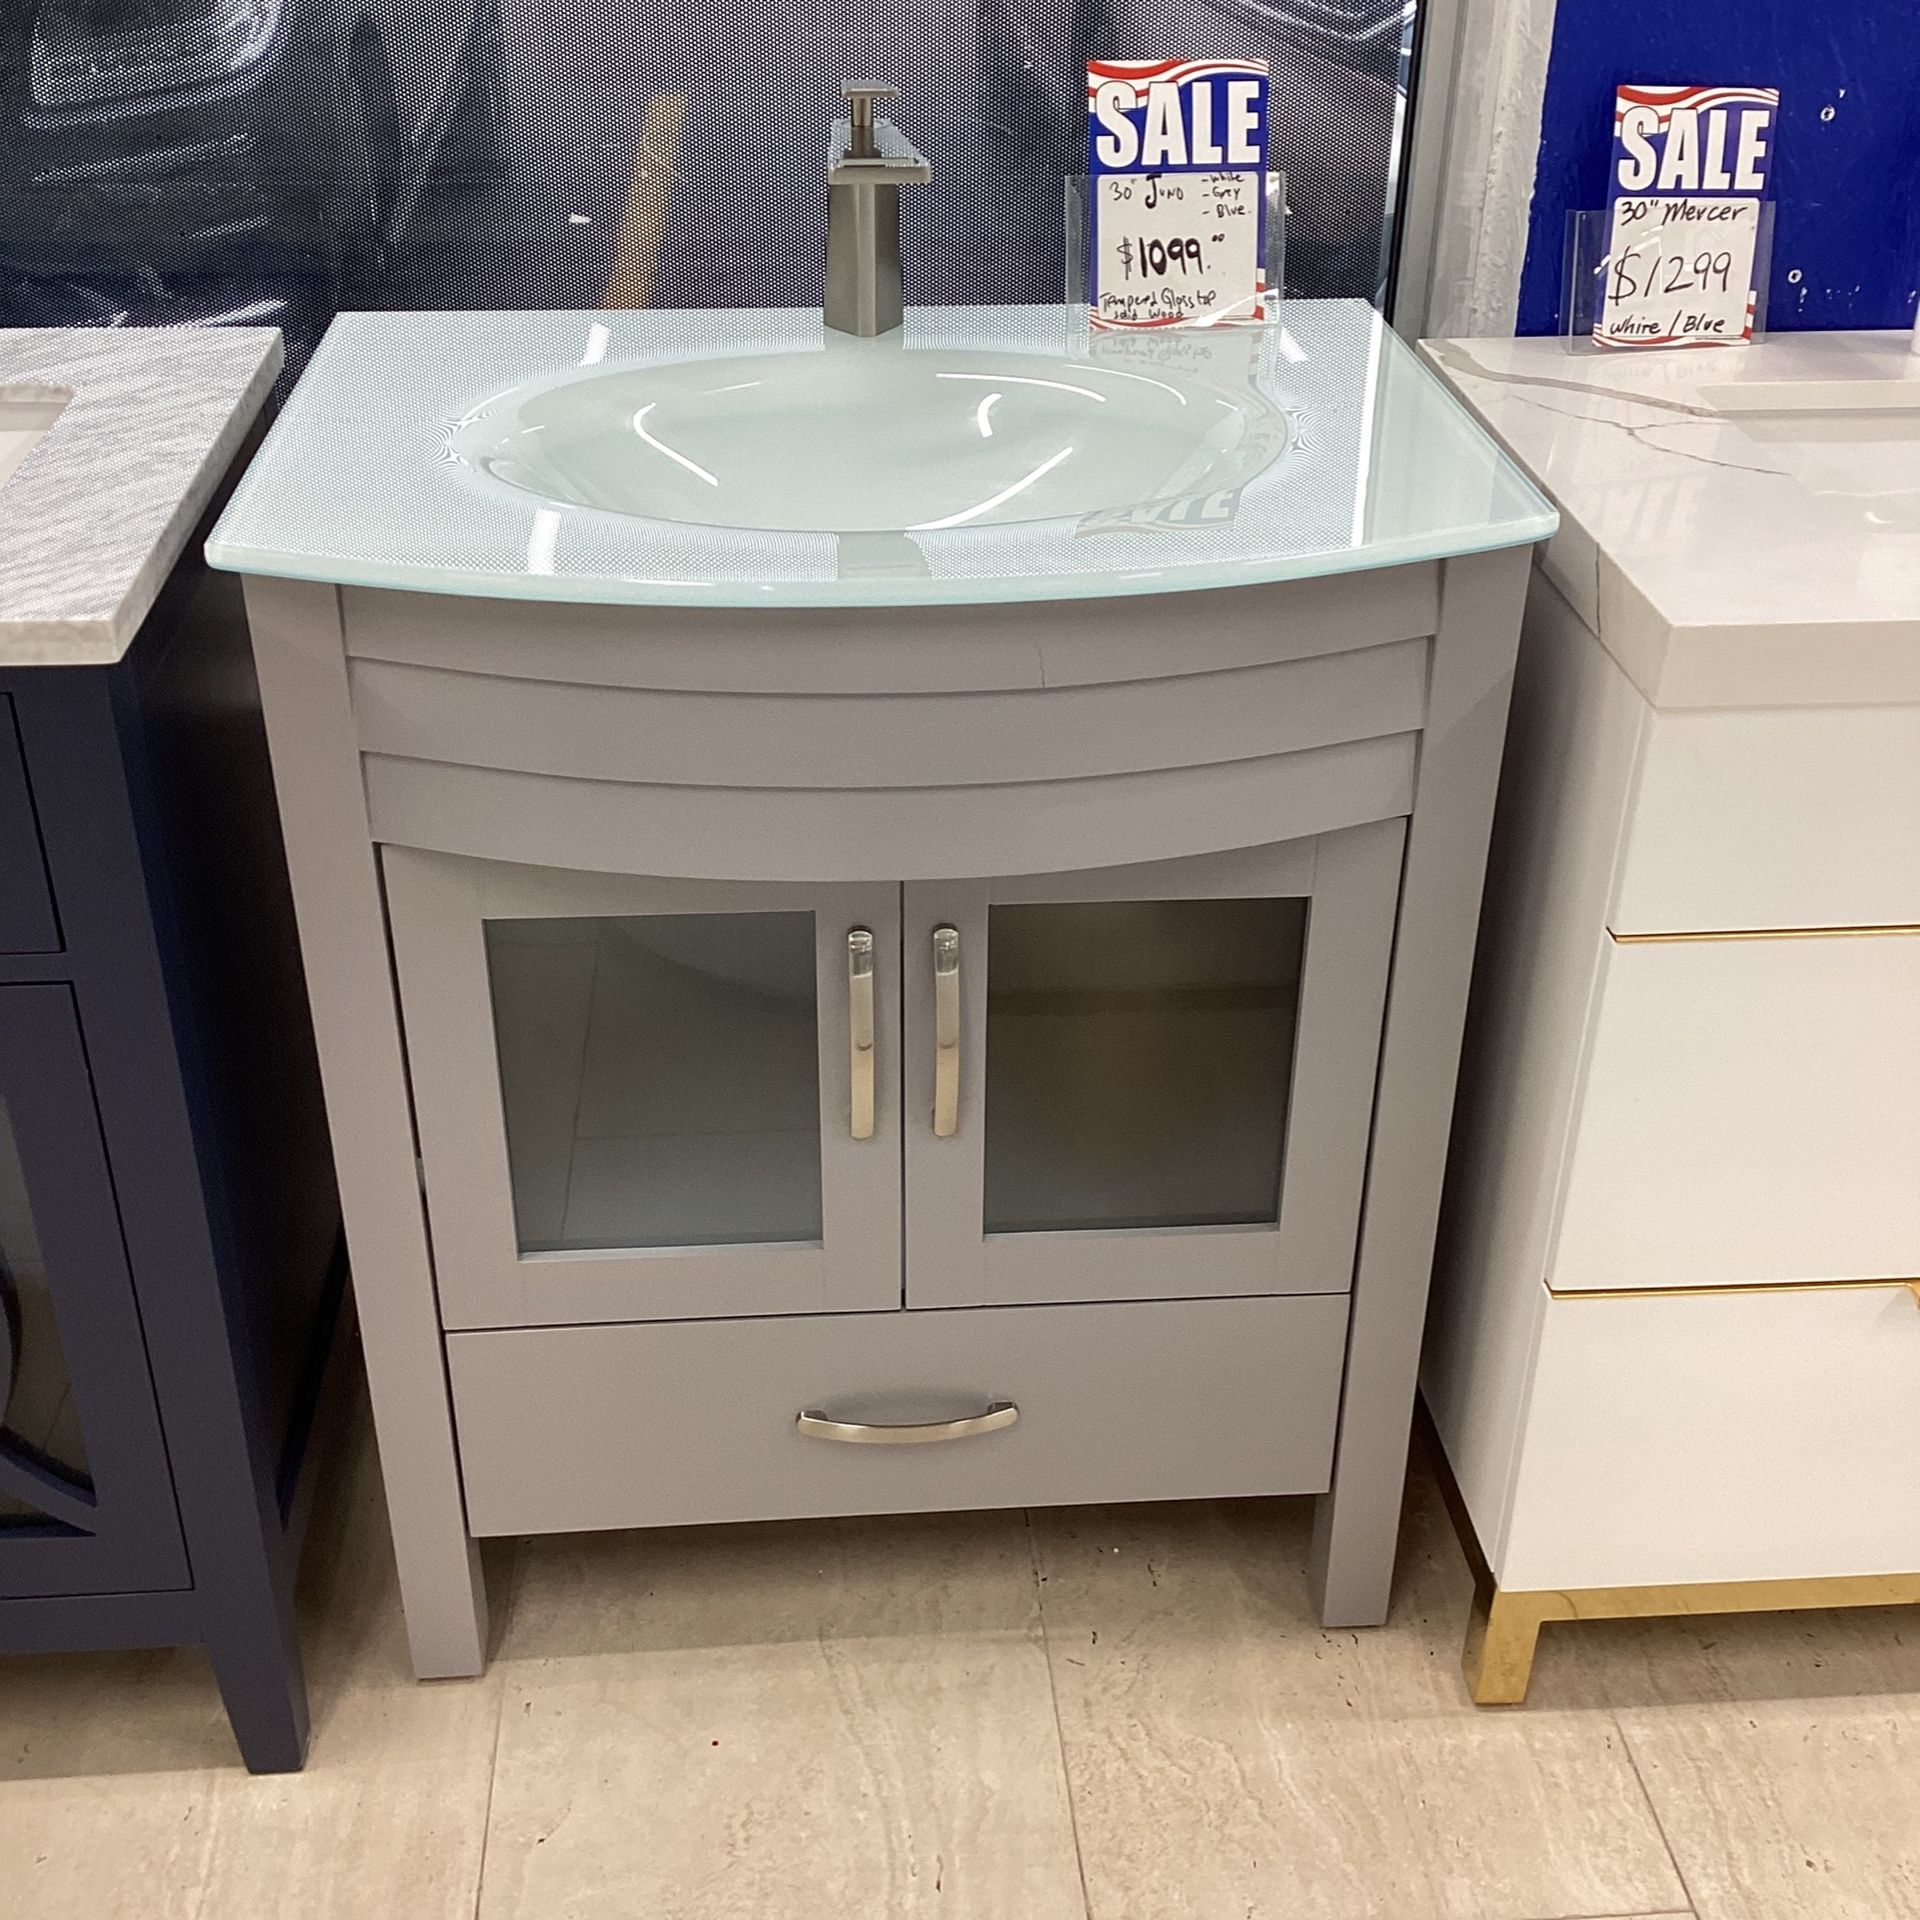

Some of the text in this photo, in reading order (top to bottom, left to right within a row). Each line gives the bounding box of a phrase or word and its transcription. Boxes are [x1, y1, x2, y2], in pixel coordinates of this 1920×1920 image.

[1095, 80, 1261, 168] SALE
[1617, 106, 1770, 191] SALE
[1621, 200, 1749, 226] 30" Mercer
[1607, 245, 1732, 306] $1299
[1683, 313, 1726, 334] Blue
